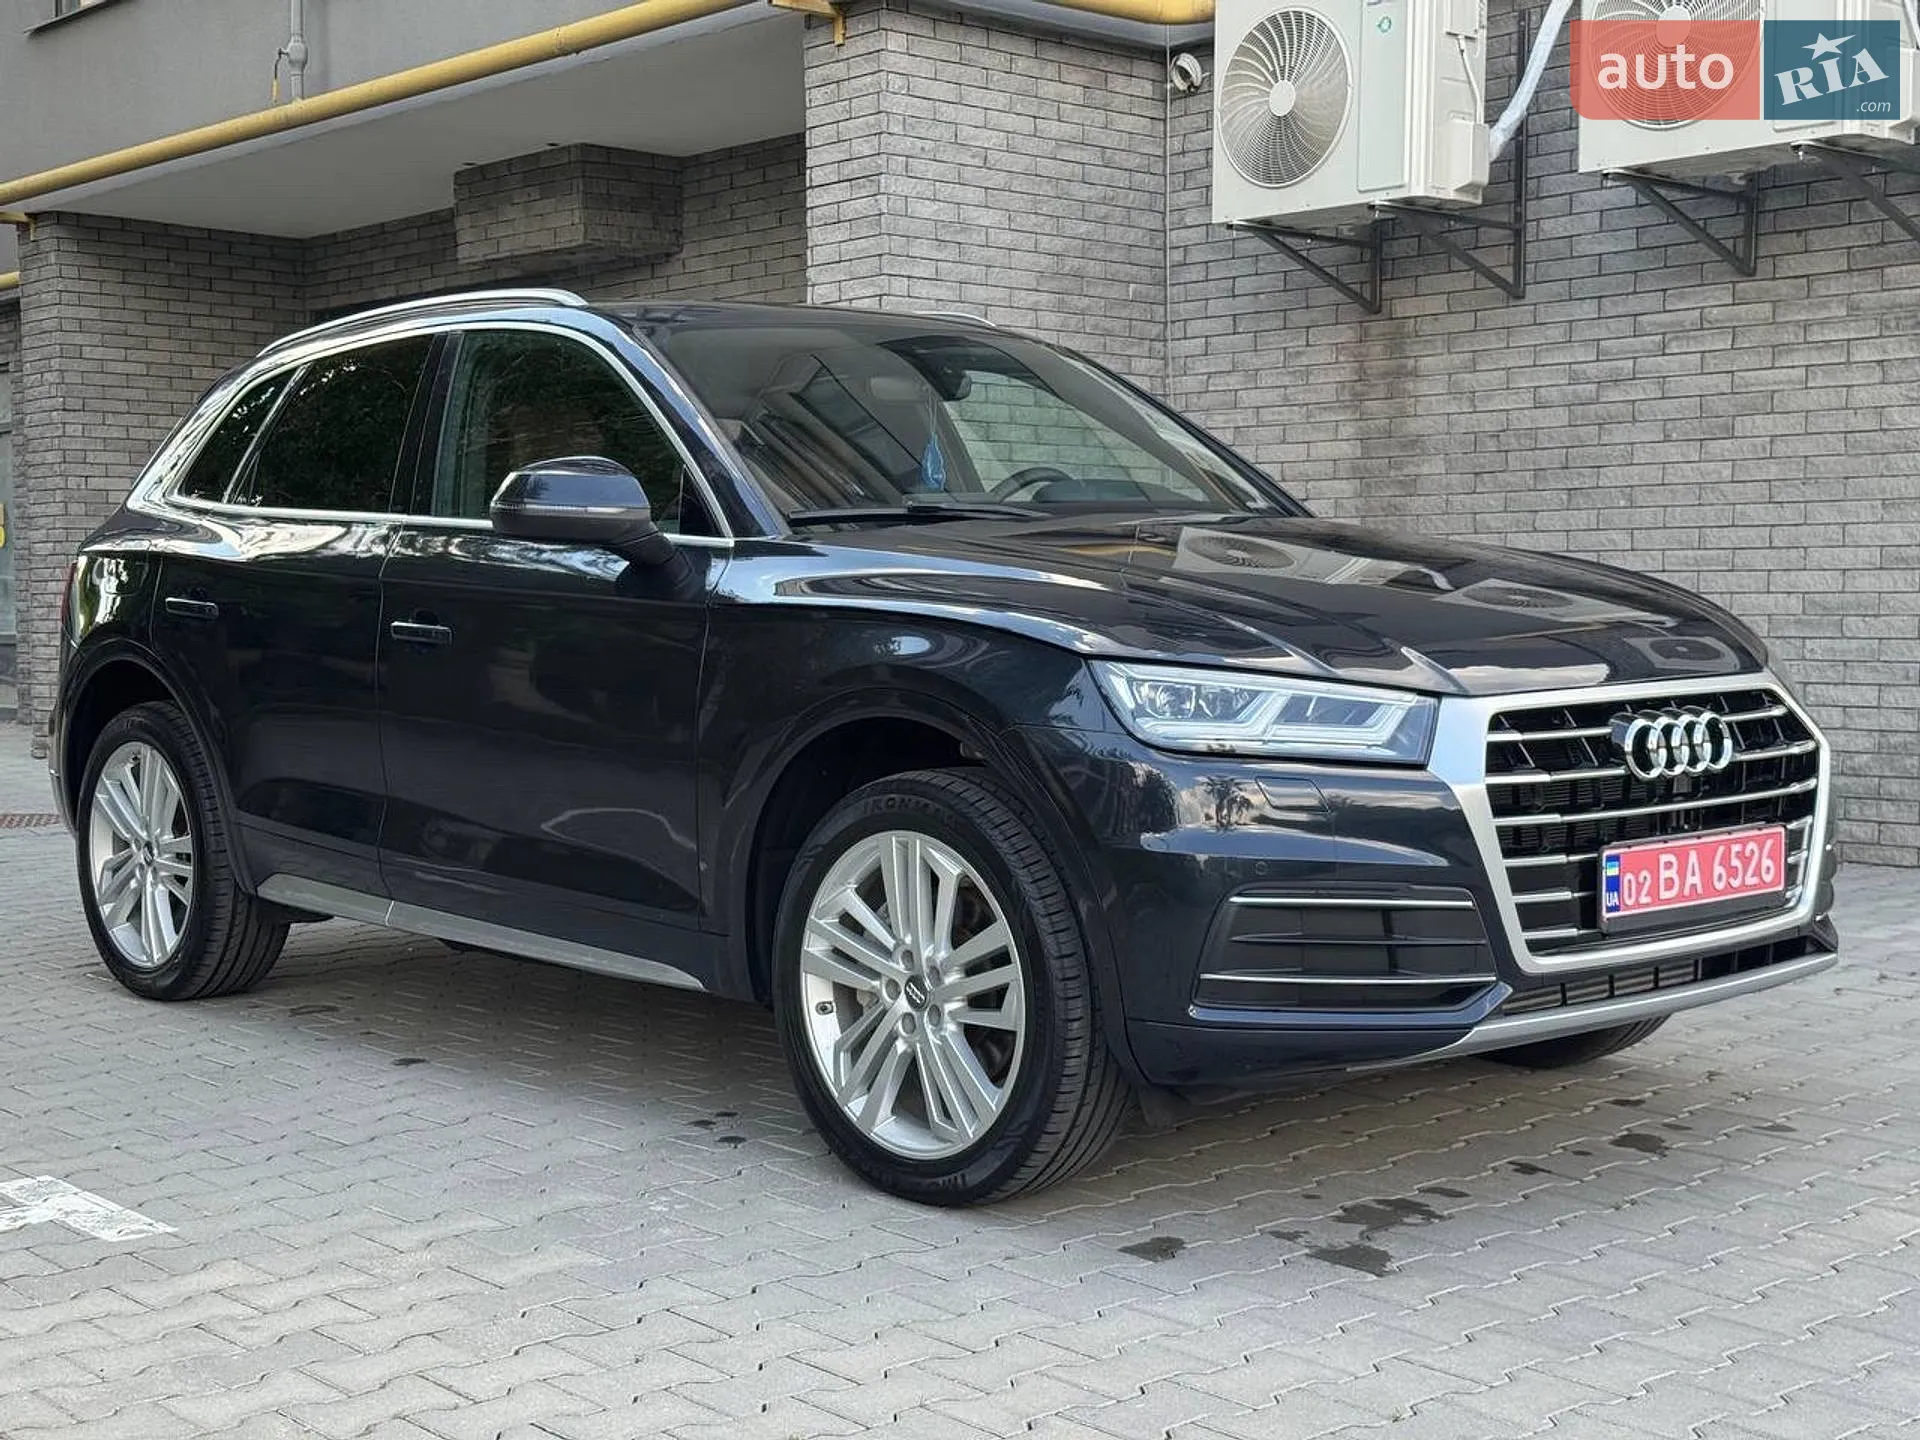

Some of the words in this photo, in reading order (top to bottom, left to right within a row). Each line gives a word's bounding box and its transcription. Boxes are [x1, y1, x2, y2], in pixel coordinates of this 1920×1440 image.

[1623, 871, 1652, 906] 02
[1658, 850, 1702, 899] BA
[1713, 839, 1775, 891] 6526
[1606, 892, 1619, 906] UA
